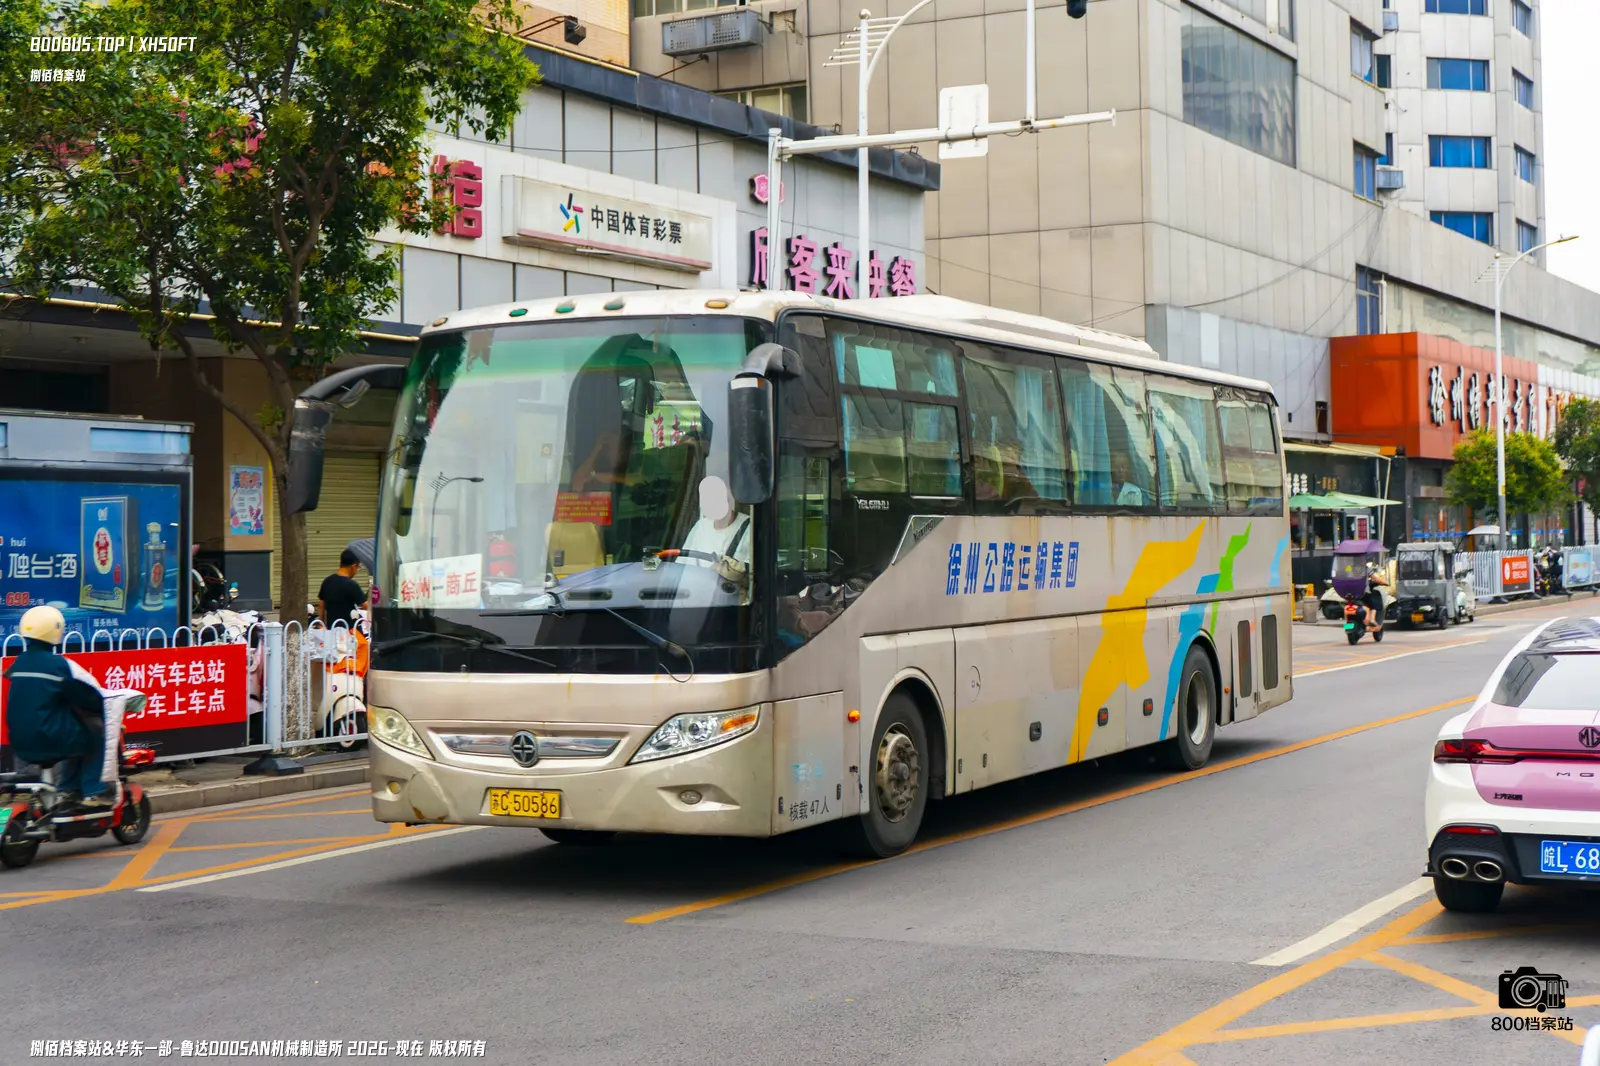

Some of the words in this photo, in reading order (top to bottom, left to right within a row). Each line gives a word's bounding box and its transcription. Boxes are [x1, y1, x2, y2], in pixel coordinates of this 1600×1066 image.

[590, 203, 682, 244] 中国体育彩票
[946, 541, 1080, 596] 徐州公路运输集团
[104, 659, 226, 690] 徐州汽车总站
